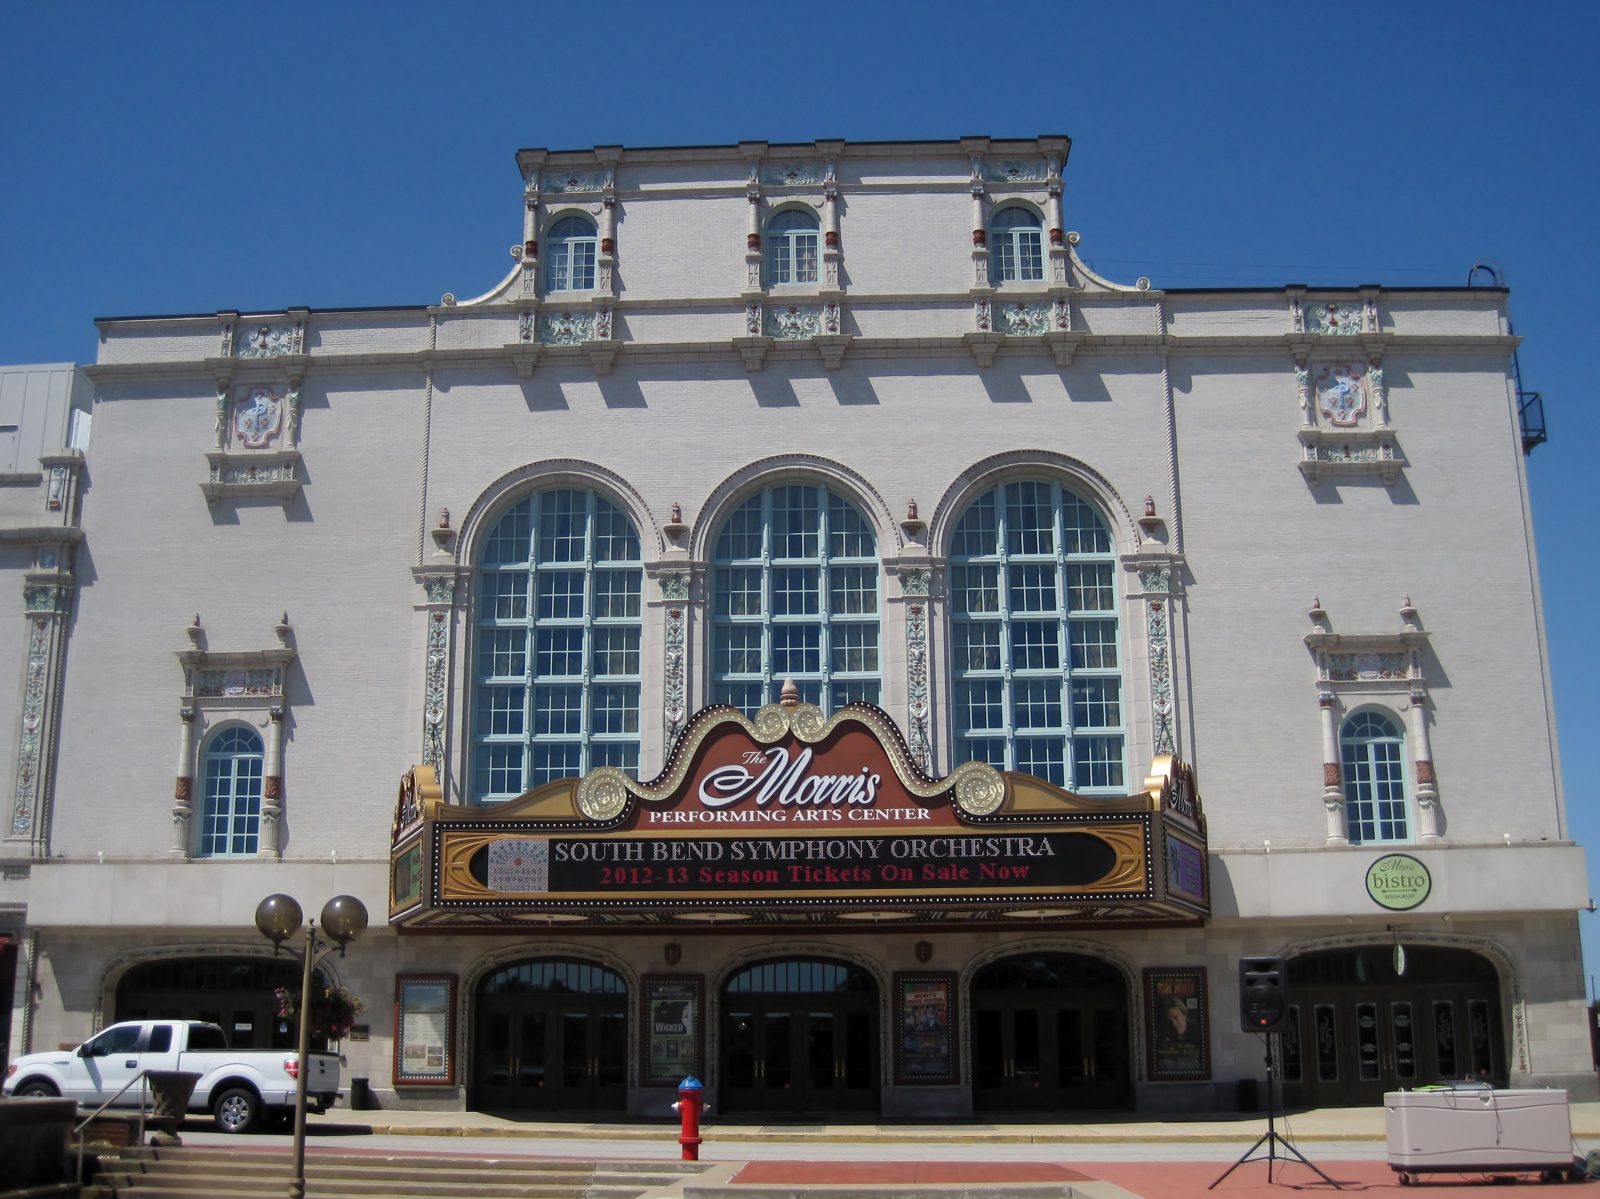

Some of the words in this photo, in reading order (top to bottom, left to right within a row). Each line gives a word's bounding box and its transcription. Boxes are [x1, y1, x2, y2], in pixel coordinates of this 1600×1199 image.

[742, 751, 767, 765] The
[699, 746, 881, 807] Morris
[649, 810, 787, 823] PERFORMING
[791, 809, 842, 822] ARTS
[847, 807, 931, 821] CENTER
[555, 842, 644, 862] SOUTH
[650, 841, 724, 861] BEND
[730, 839, 884, 861] SYMPHONY
[890, 836, 1055, 858] ORCHESTRA
[600, 866, 688, 884] 2012-13
[699, 866, 780, 884] Season
[787, 864, 872, 883] Tickets
[879, 864, 914, 882] On
[922, 863, 971, 881] Sale
[979, 862, 1029, 880] Now
[1372, 873, 1425, 889] bistro
